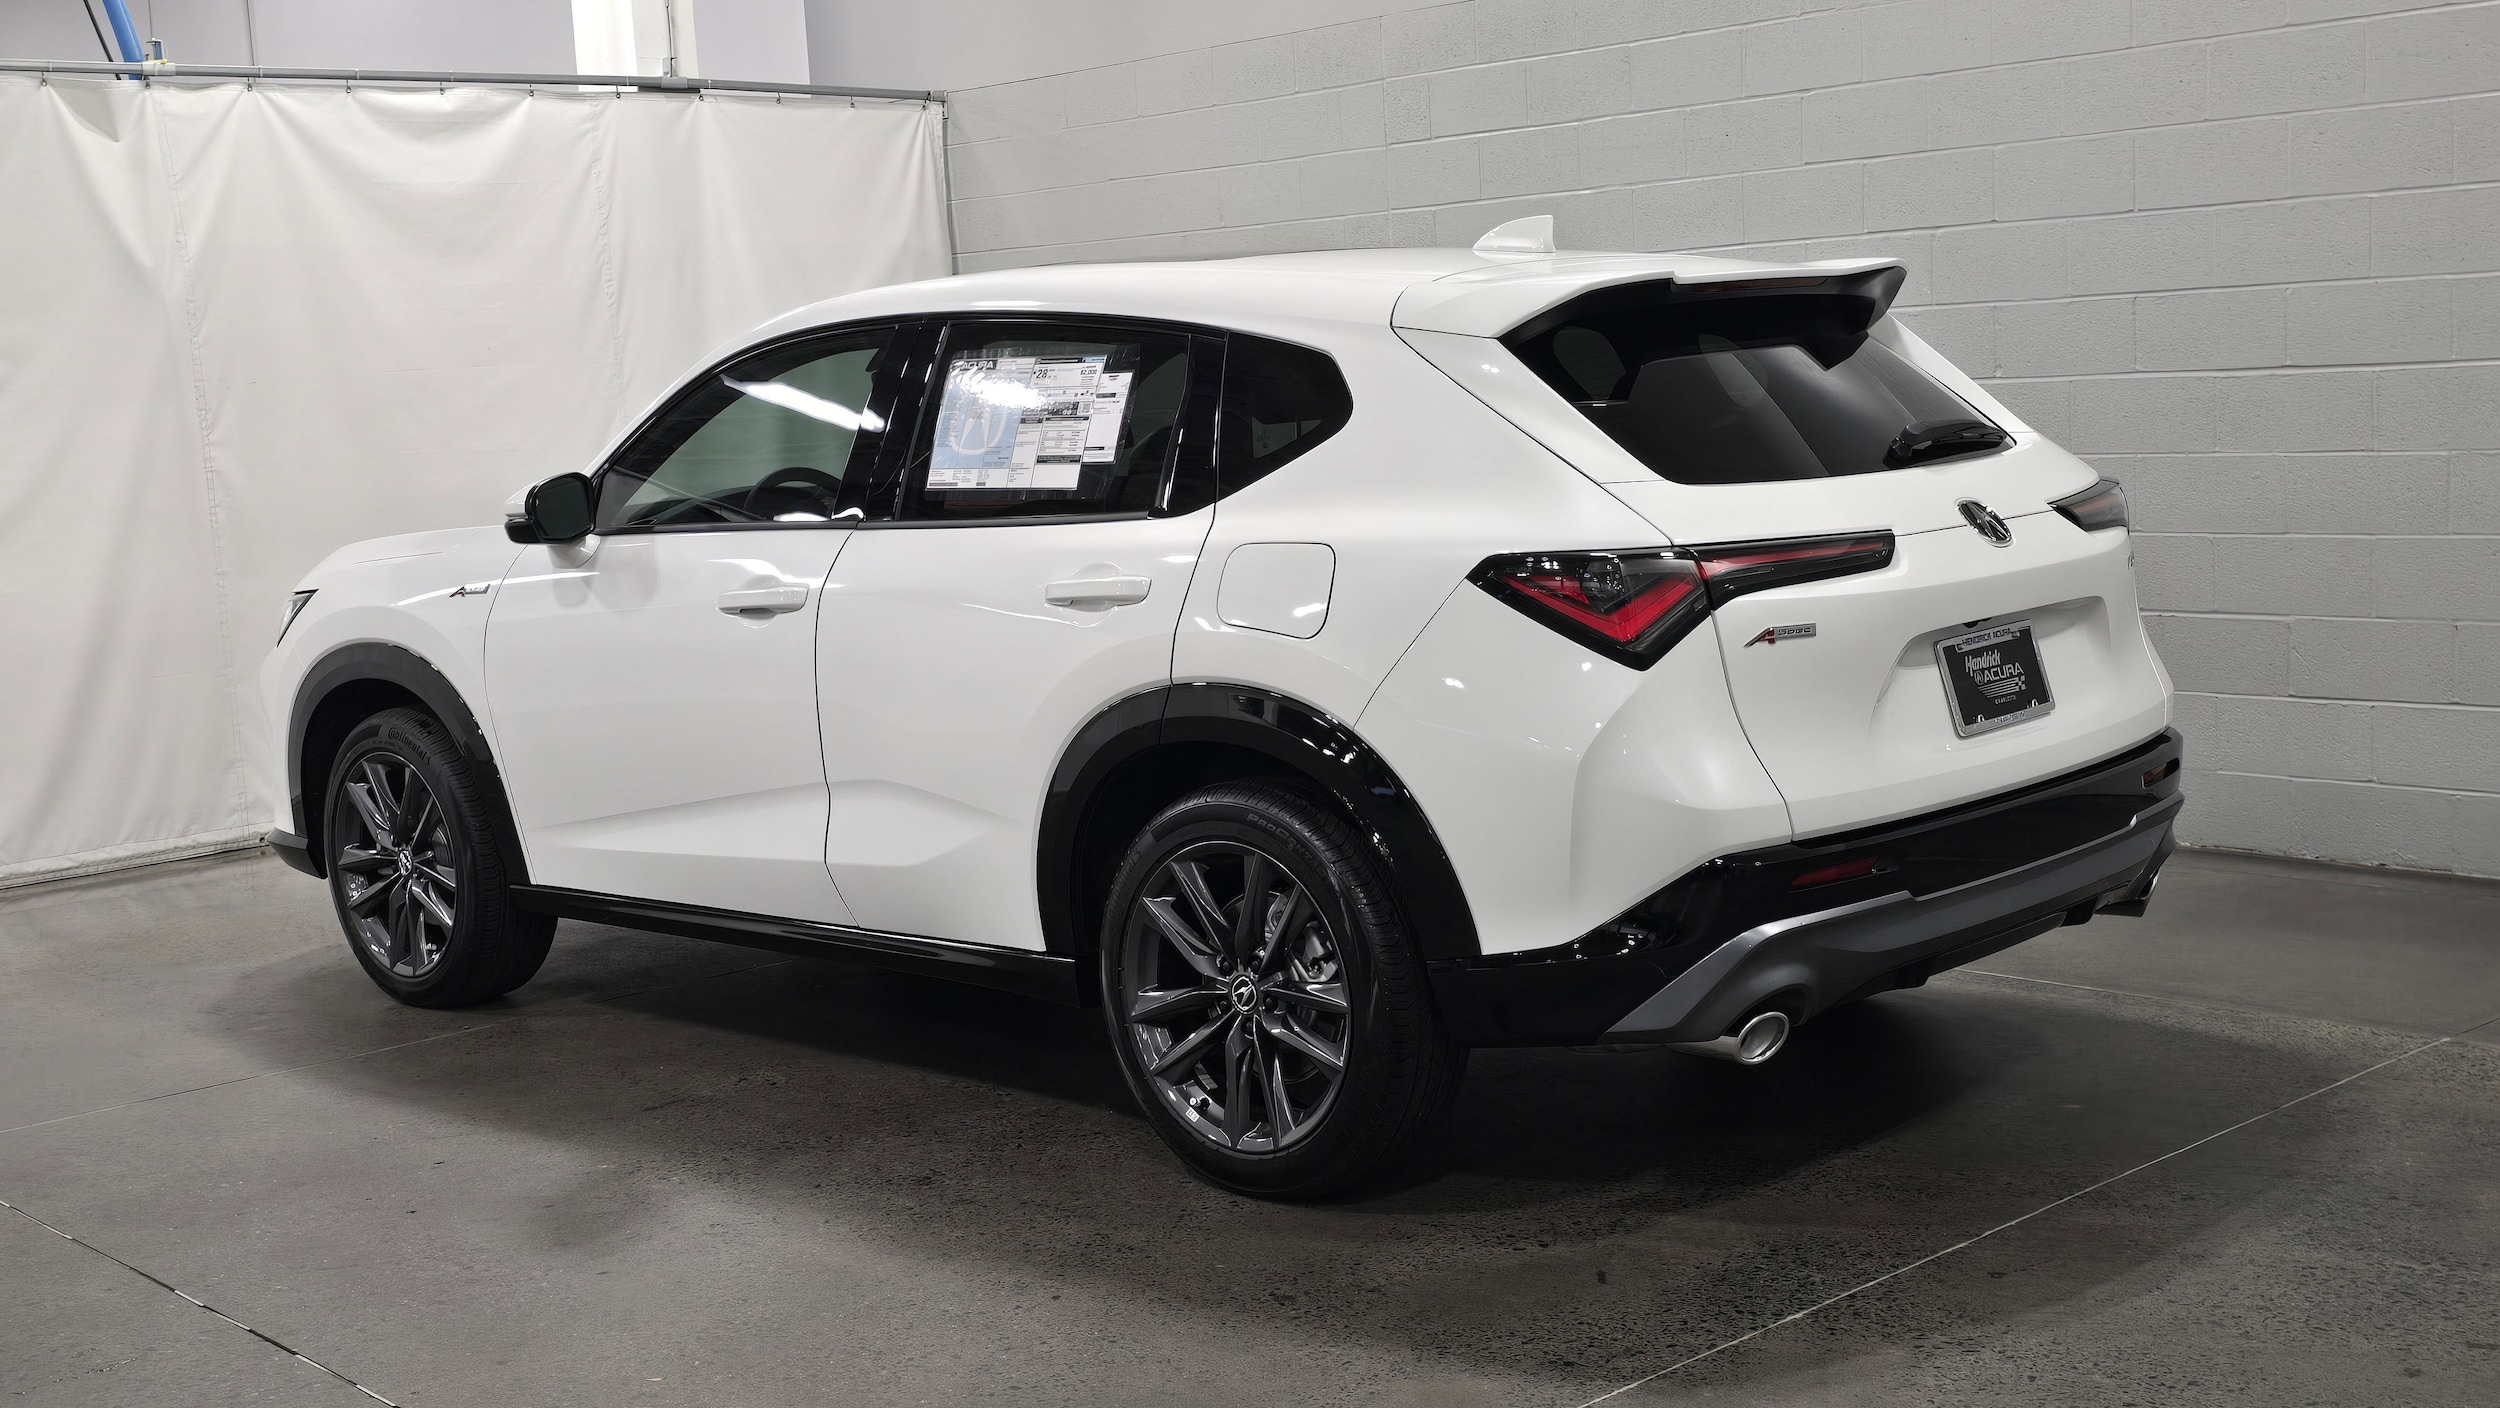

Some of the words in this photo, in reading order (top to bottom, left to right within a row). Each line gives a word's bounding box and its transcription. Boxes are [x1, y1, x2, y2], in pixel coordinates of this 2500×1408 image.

[962, 361, 994, 370] ACURA
[1036, 369, 1048, 379] 28
[1965, 649, 2001, 677] Hendrick
[1984, 662, 2025, 683] ACURA
[388, 727, 428, 760] Continental
